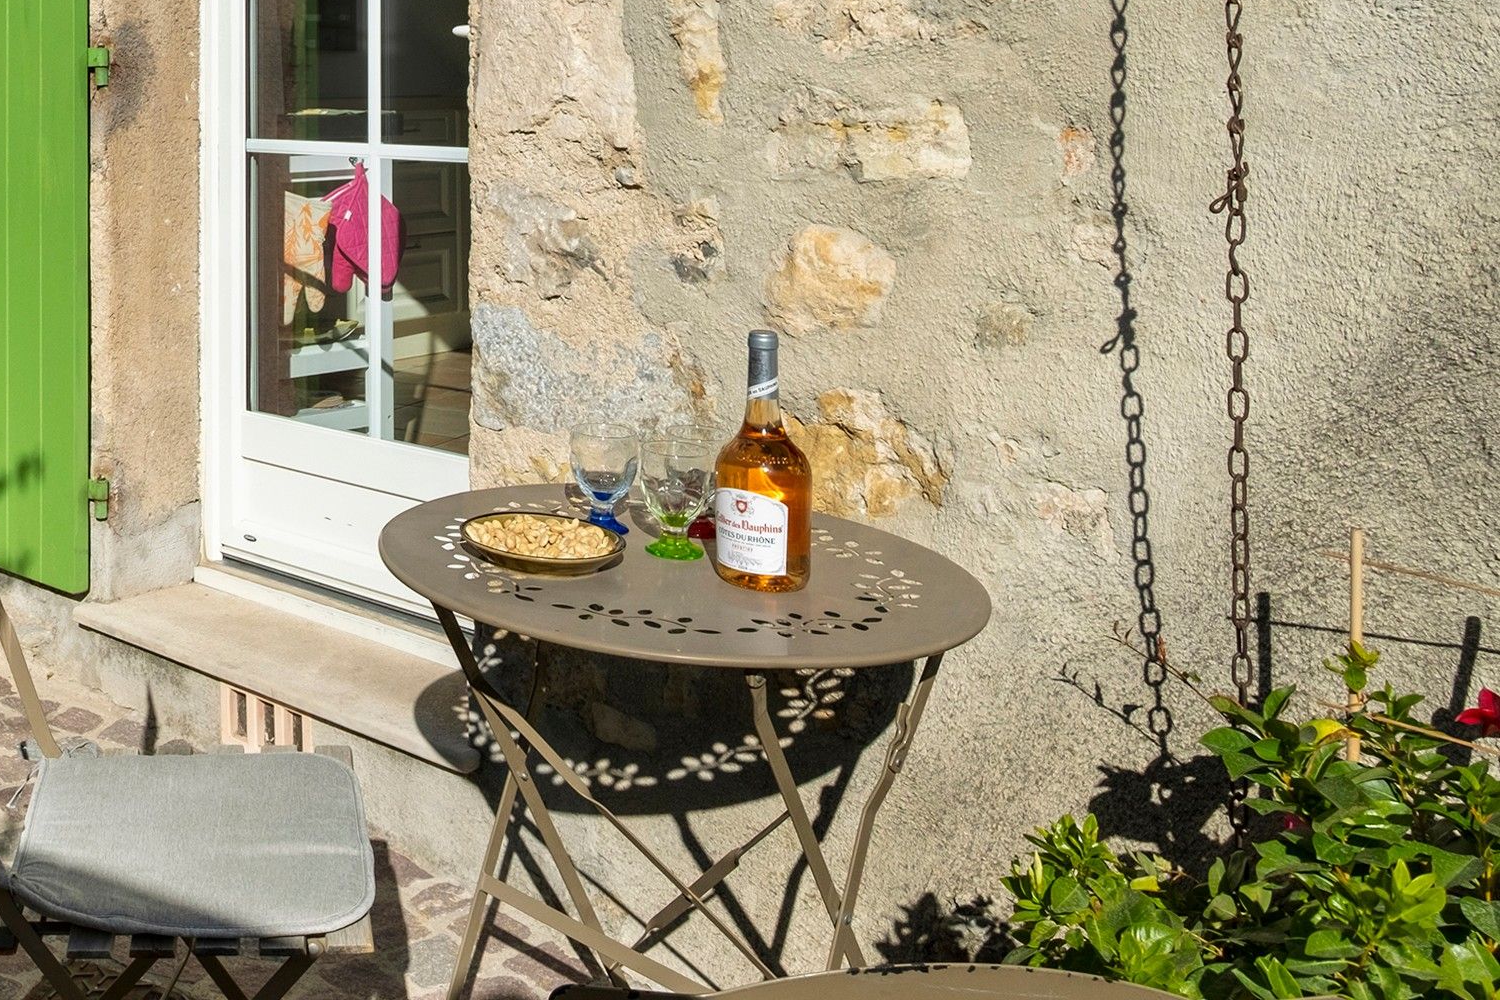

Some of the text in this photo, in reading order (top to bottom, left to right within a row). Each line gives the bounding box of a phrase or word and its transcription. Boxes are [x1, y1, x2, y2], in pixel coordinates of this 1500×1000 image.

[742, 520, 783, 534] Dauphins
[736, 533, 747, 542] DU
[747, 535, 776, 545] RHÔNE
